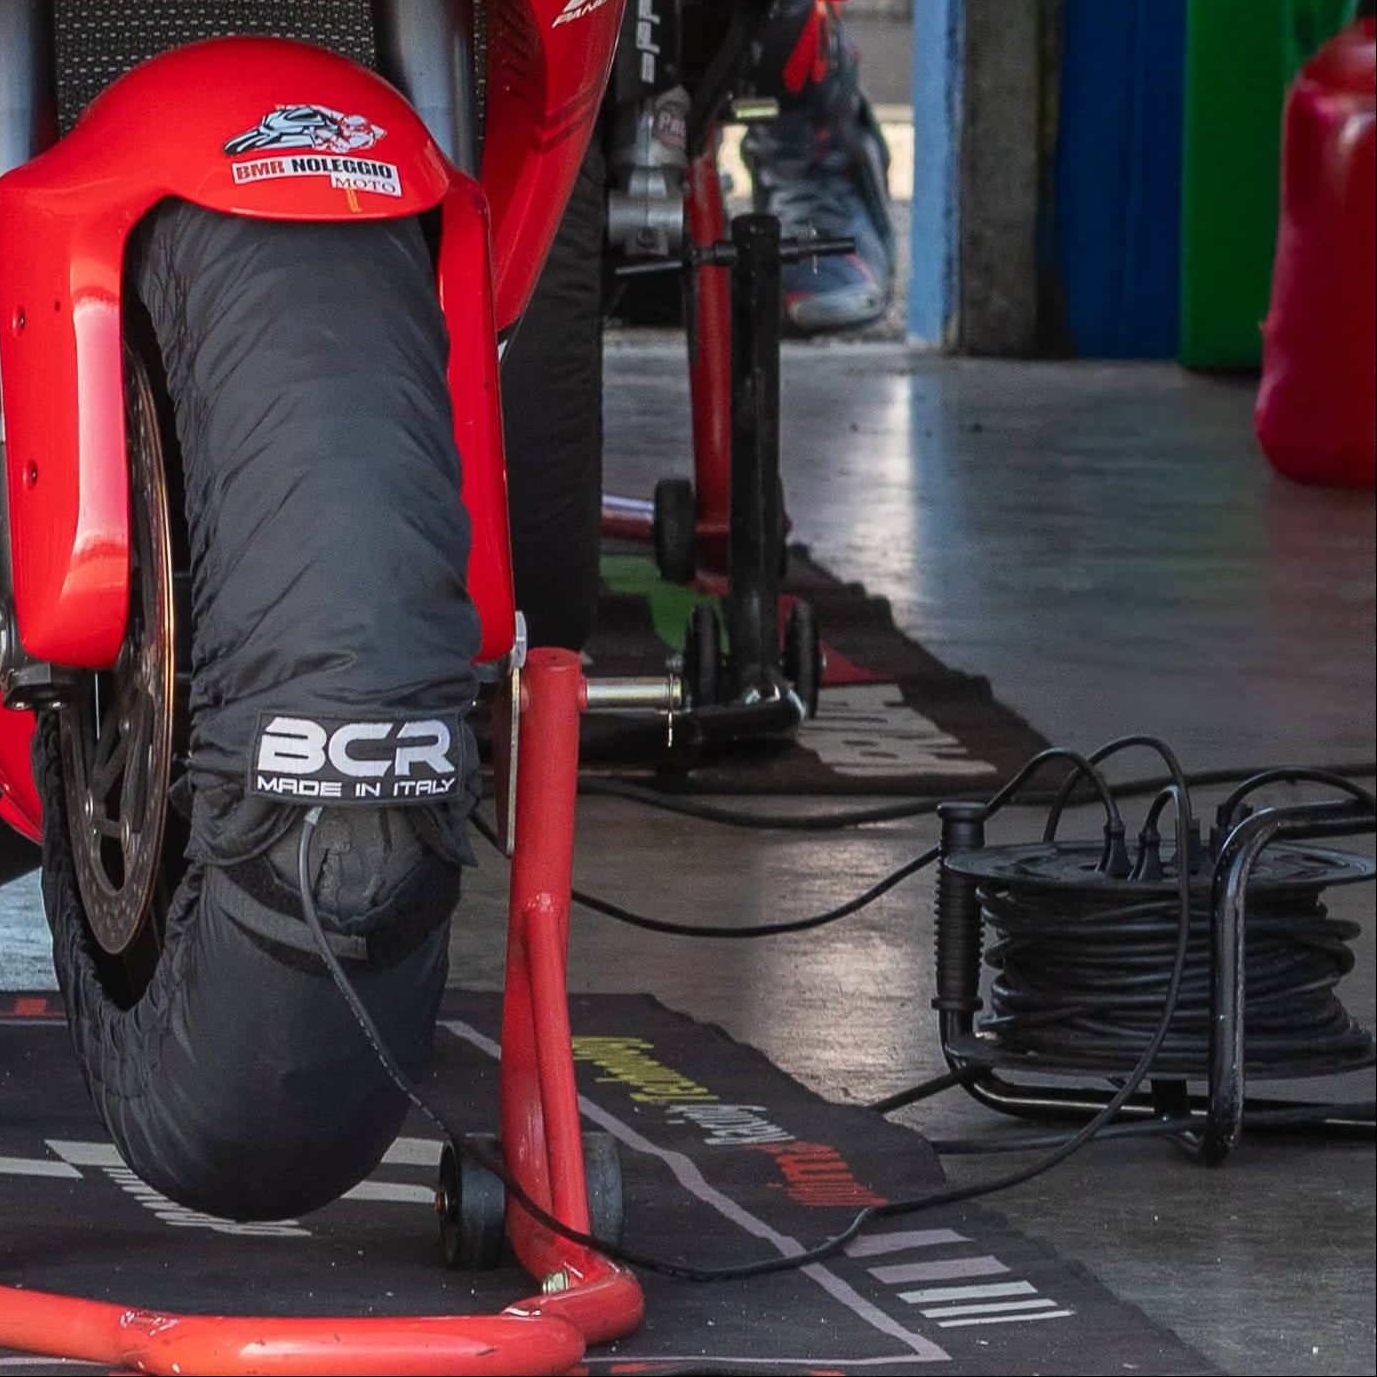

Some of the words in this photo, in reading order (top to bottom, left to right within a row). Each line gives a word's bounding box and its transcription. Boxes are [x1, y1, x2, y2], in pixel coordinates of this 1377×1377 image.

[235, 160, 286, 181] BMR
[291, 157, 393, 180] NOLEGGIO
[334, 175, 396, 194] MOTO
[256, 716, 455, 778] BCR
[257, 775, 342, 798] MADE
[355, 782, 380, 797] IN
[393, 777, 455, 798] ITALY
